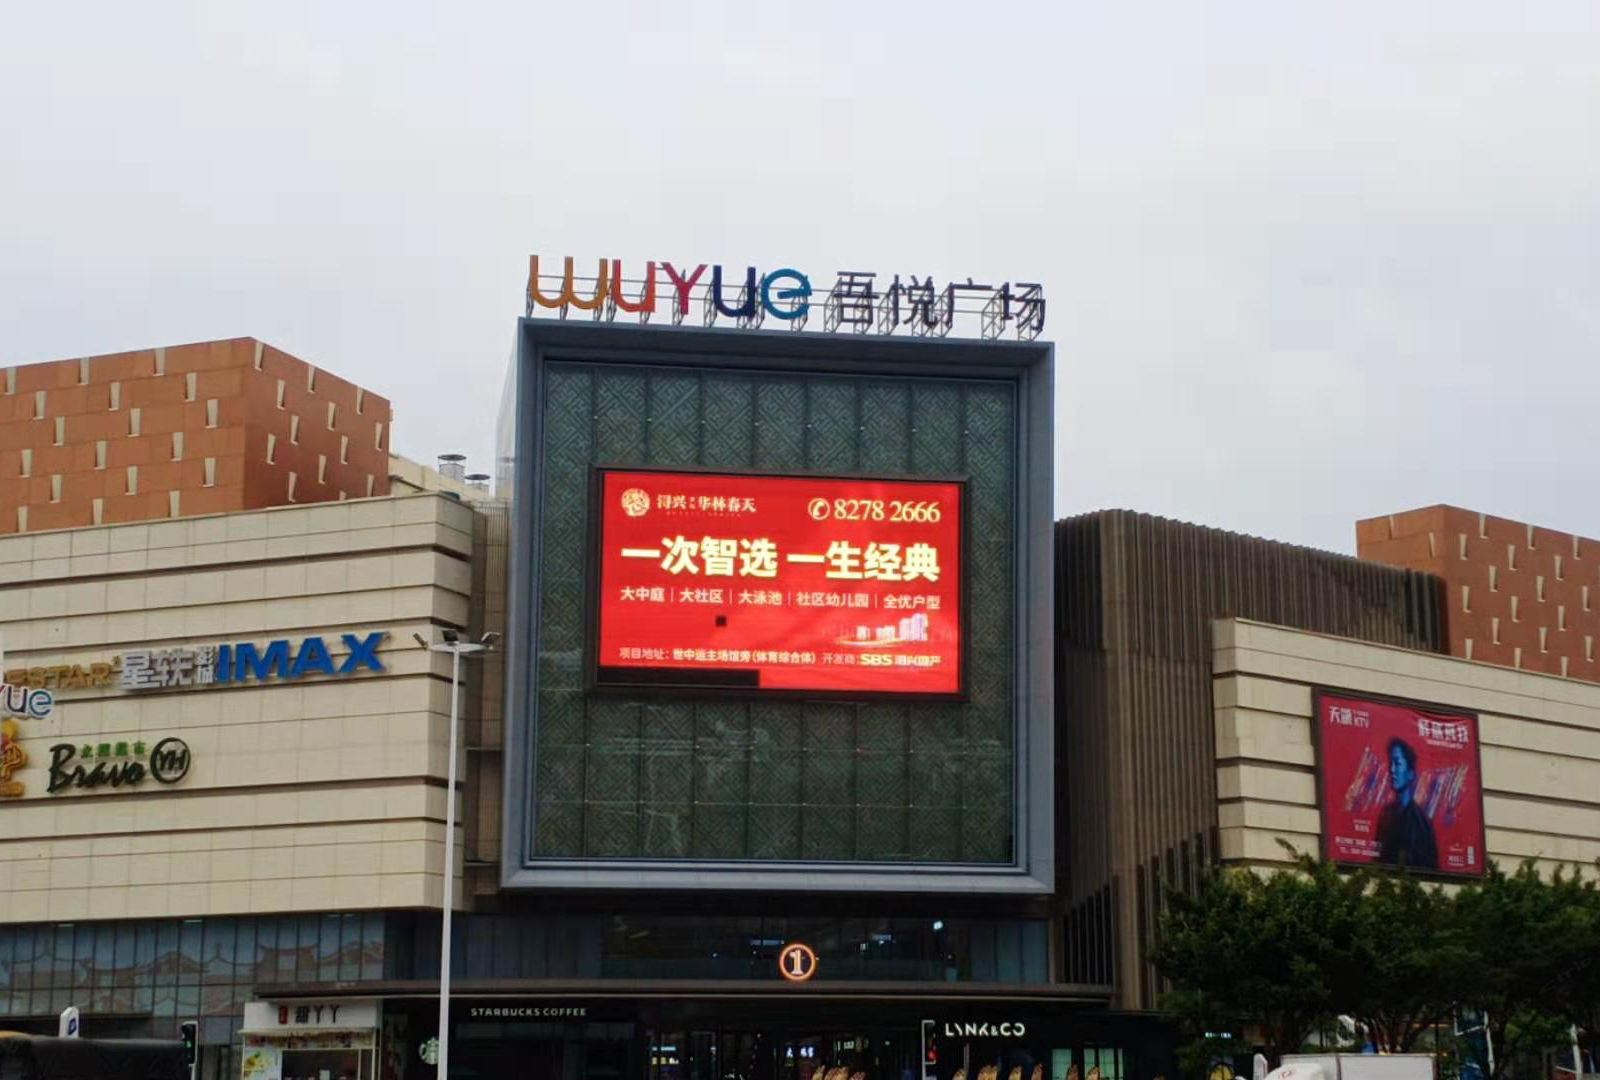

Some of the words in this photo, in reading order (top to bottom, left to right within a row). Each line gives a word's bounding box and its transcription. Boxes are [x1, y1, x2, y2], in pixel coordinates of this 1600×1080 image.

[835, 270, 1046, 331] 吾悦广场
[834, 499, 885, 521] 8278
[890, 501, 941, 523] 2666
[621, 535, 777, 578] 一次智选
[787, 540, 940, 582] 一生经典
[620, 586, 665, 602] 大中庭
[679, 587, 724, 604] 大社区
[738, 588, 783, 605] 大泳池
[796, 591, 869, 608] 社区幼儿园
[883, 593, 941, 610] 全优户型
[215, 632, 387, 683] IMAX
[860, 653, 893, 666] SBS
[47, 743, 146, 793] Bravo
[470, 1007, 540, 1017] STARBUCKS
[542, 1007, 587, 1017] COFFEE
